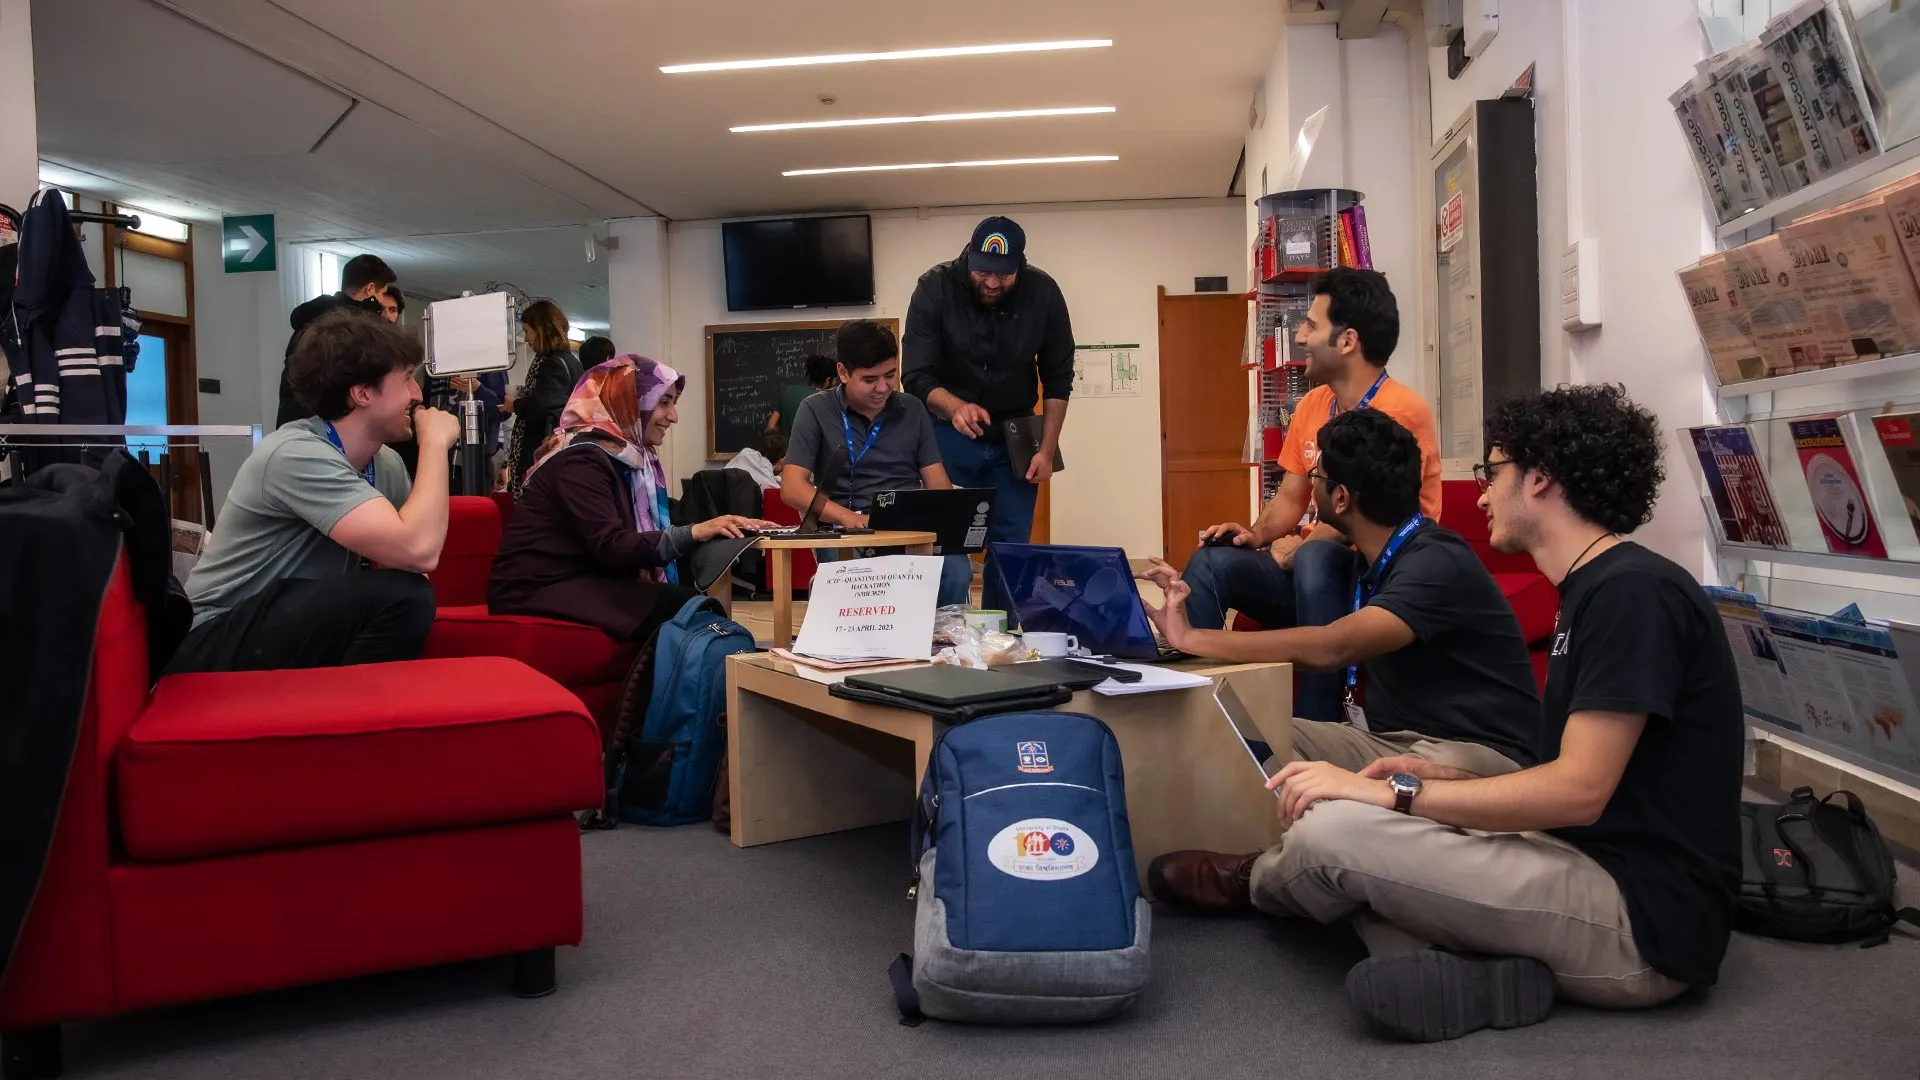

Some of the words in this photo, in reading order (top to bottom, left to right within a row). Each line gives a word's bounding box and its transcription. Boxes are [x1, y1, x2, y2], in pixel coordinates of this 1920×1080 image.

[1782, 61, 1814, 132] PICCOLO
[1734, 98, 1761, 164] PICCOLO
[1688, 118, 1717, 178] PICCOLO
[1810, 134, 1820, 151] IL
[1736, 160, 1745, 175] IL
[1759, 165, 1769, 181] IL
[1713, 179, 1722, 193] IL
[887, 573, 923, 581] QUANTUM
[1054, 579, 1076, 587] ASUS
[851, 582, 890, 590] HACKATHON
[838, 605, 896, 617] RESERVED
[856, 624, 877, 632] APRIL
